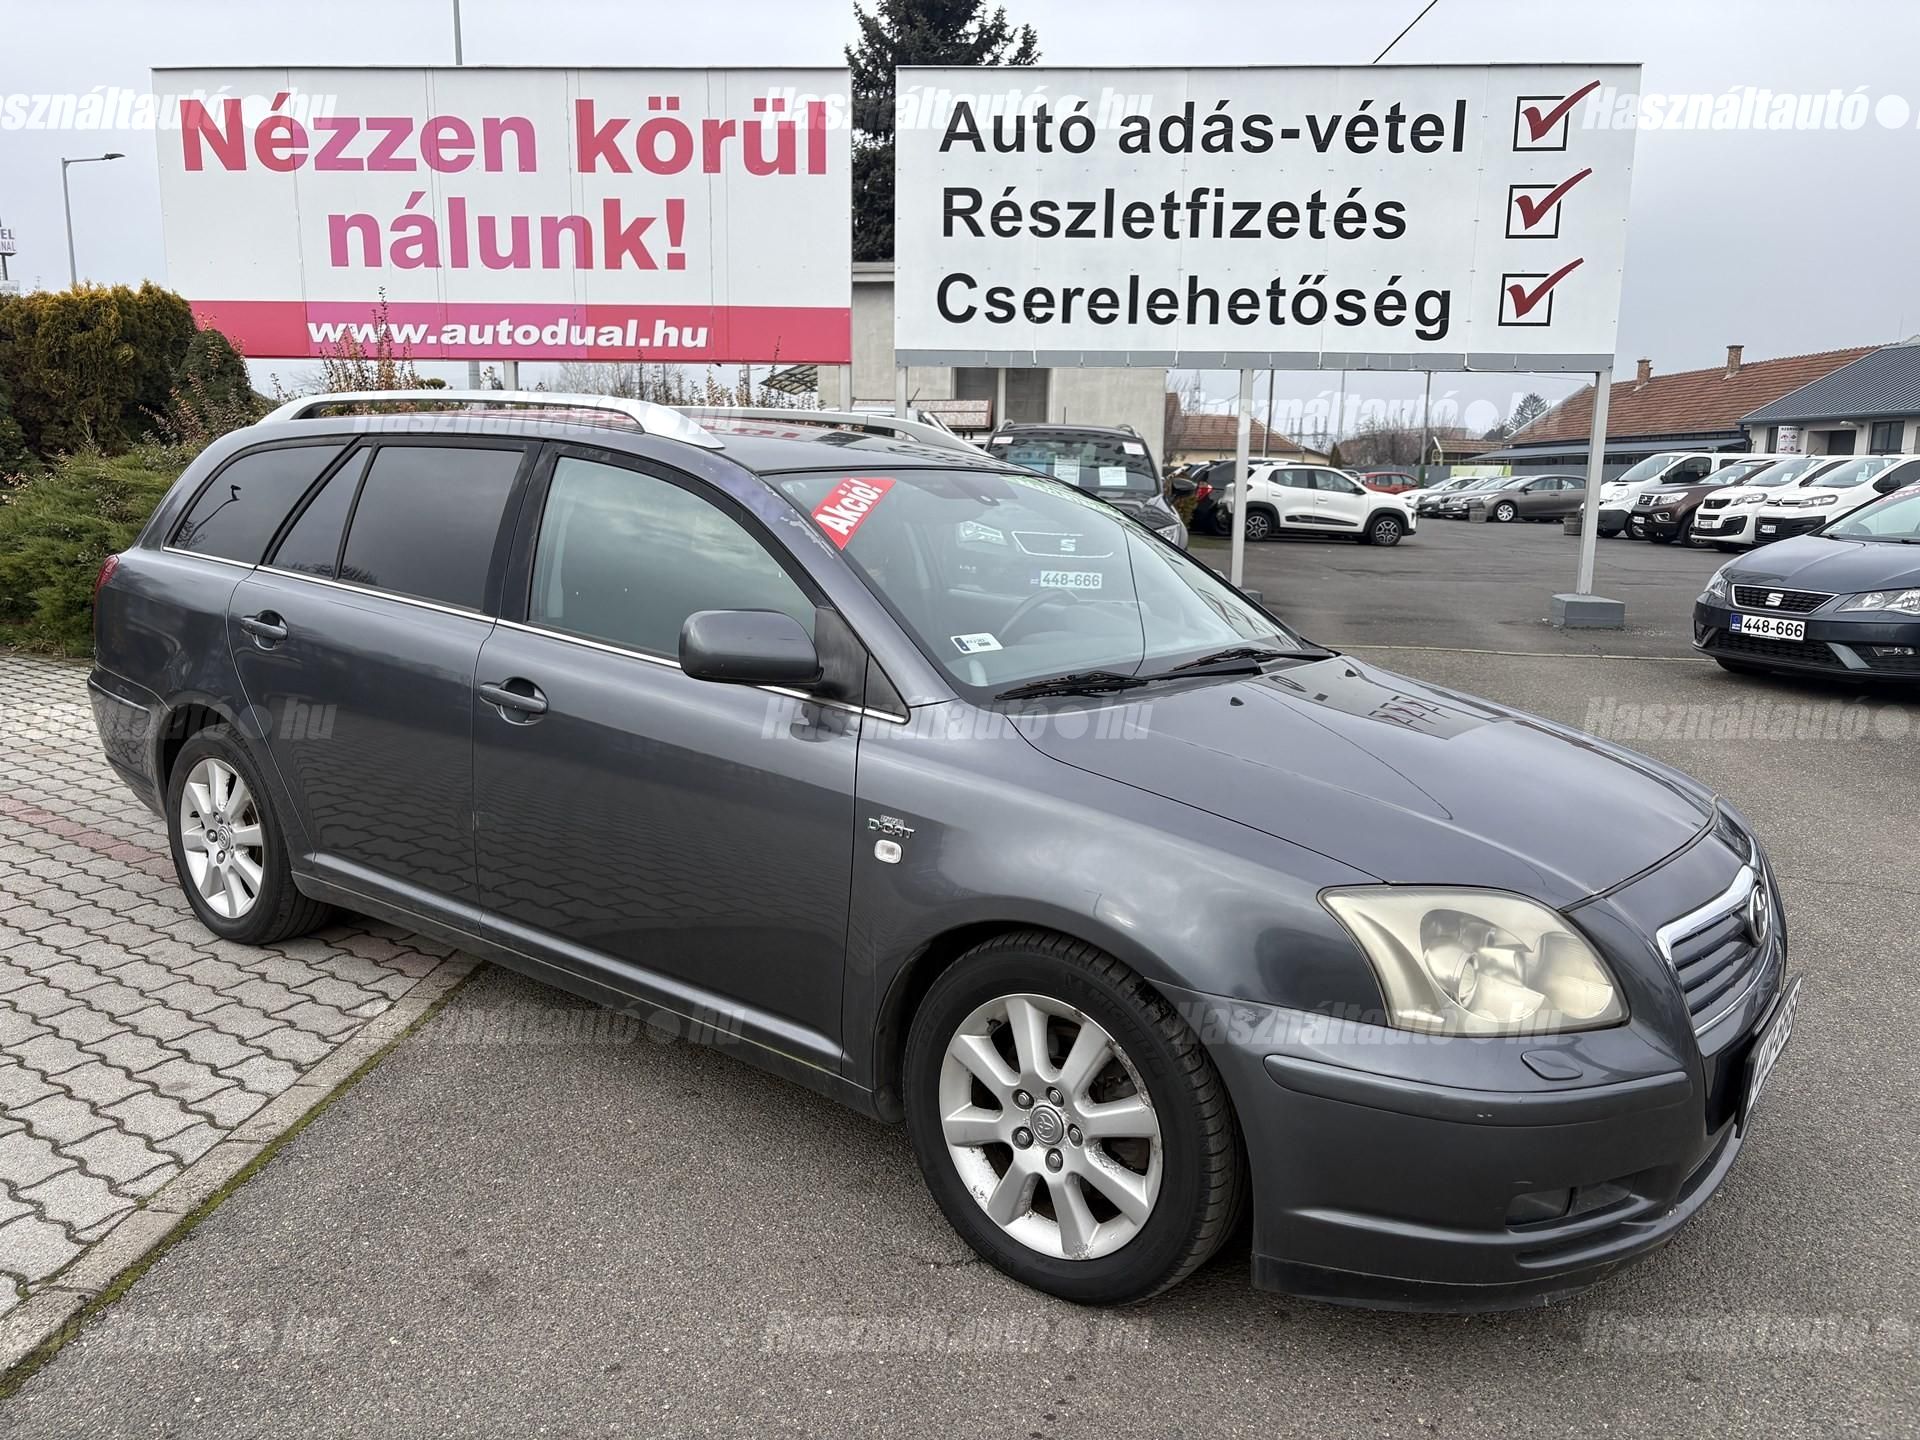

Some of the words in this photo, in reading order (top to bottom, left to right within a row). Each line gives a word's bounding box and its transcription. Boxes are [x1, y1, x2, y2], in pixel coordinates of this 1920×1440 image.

[180, 92, 537, 173] Nézzen
[575, 96, 827, 176] körül
[939, 100, 1096, 153] Autó
[1118, 99, 1467, 153] adás-vétel
[327, 191, 686, 270] nálunk!
[943, 186, 1407, 239] Részletfizetés
[307, 318, 708, 348] www.autodual.hu
[936, 272, 1451, 341] Cserelehetőség
[815, 478, 883, 536] Akció!
[1042, 572, 1100, 587] 448-666
[1743, 617, 1803, 638] 448-666
